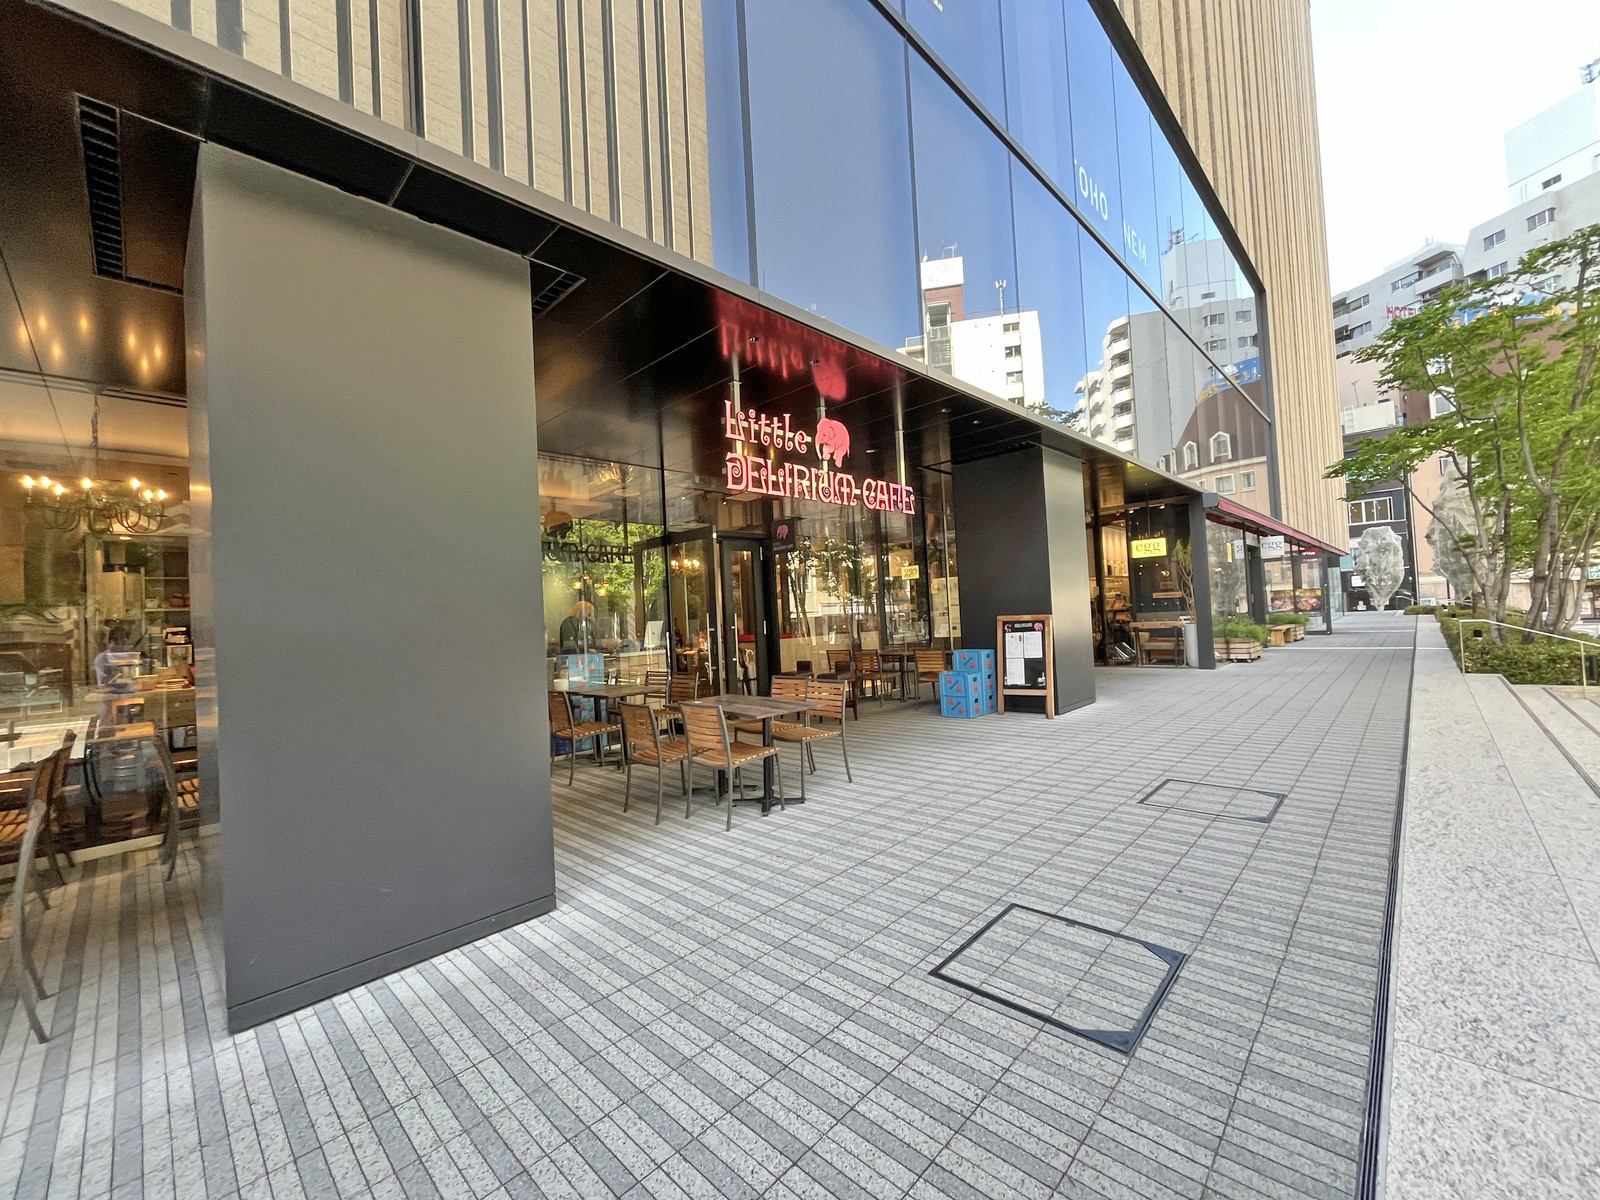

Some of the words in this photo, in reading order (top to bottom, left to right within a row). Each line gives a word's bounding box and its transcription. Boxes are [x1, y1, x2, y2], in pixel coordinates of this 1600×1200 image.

[1074, 158, 1108, 220] OHO
[724, 400, 808, 453] Little
[726, 452, 857, 506] DELIRIUM
[862, 478, 915, 515] CAFE
[1135, 541, 1162, 555] egg
[1261, 540, 1283, 551] egg
